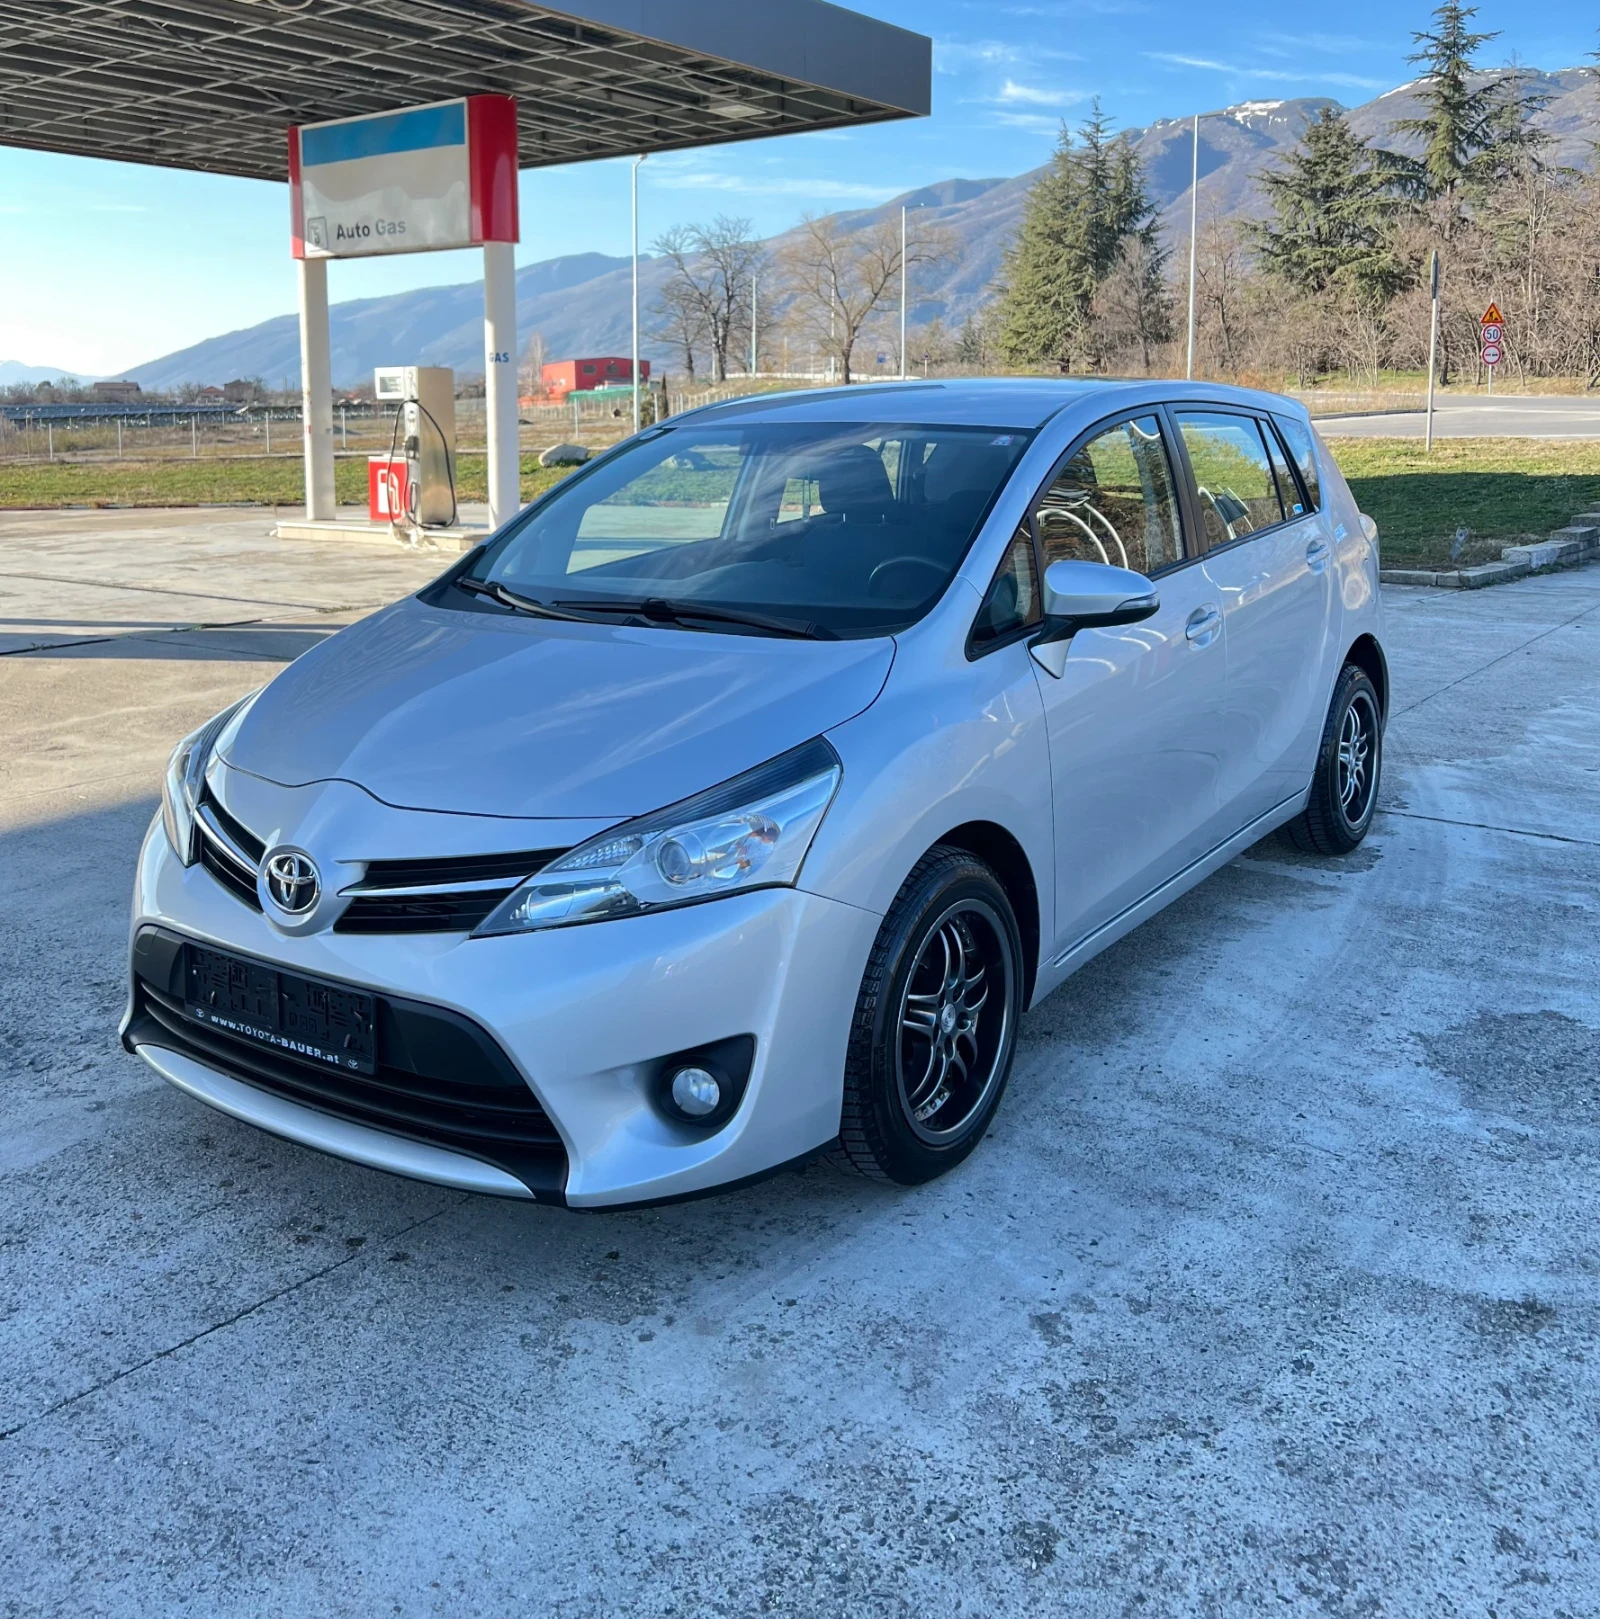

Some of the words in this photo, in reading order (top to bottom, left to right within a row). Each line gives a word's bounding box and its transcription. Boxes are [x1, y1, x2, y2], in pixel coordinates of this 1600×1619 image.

[336, 222, 370, 240] Auto
[375, 219, 406, 236] Gas
[1486, 328, 1499, 339] 50
[488, 352, 509, 363] GAS
[211, 1014, 340, 1063] www.TOYOTA-BAUER.at
